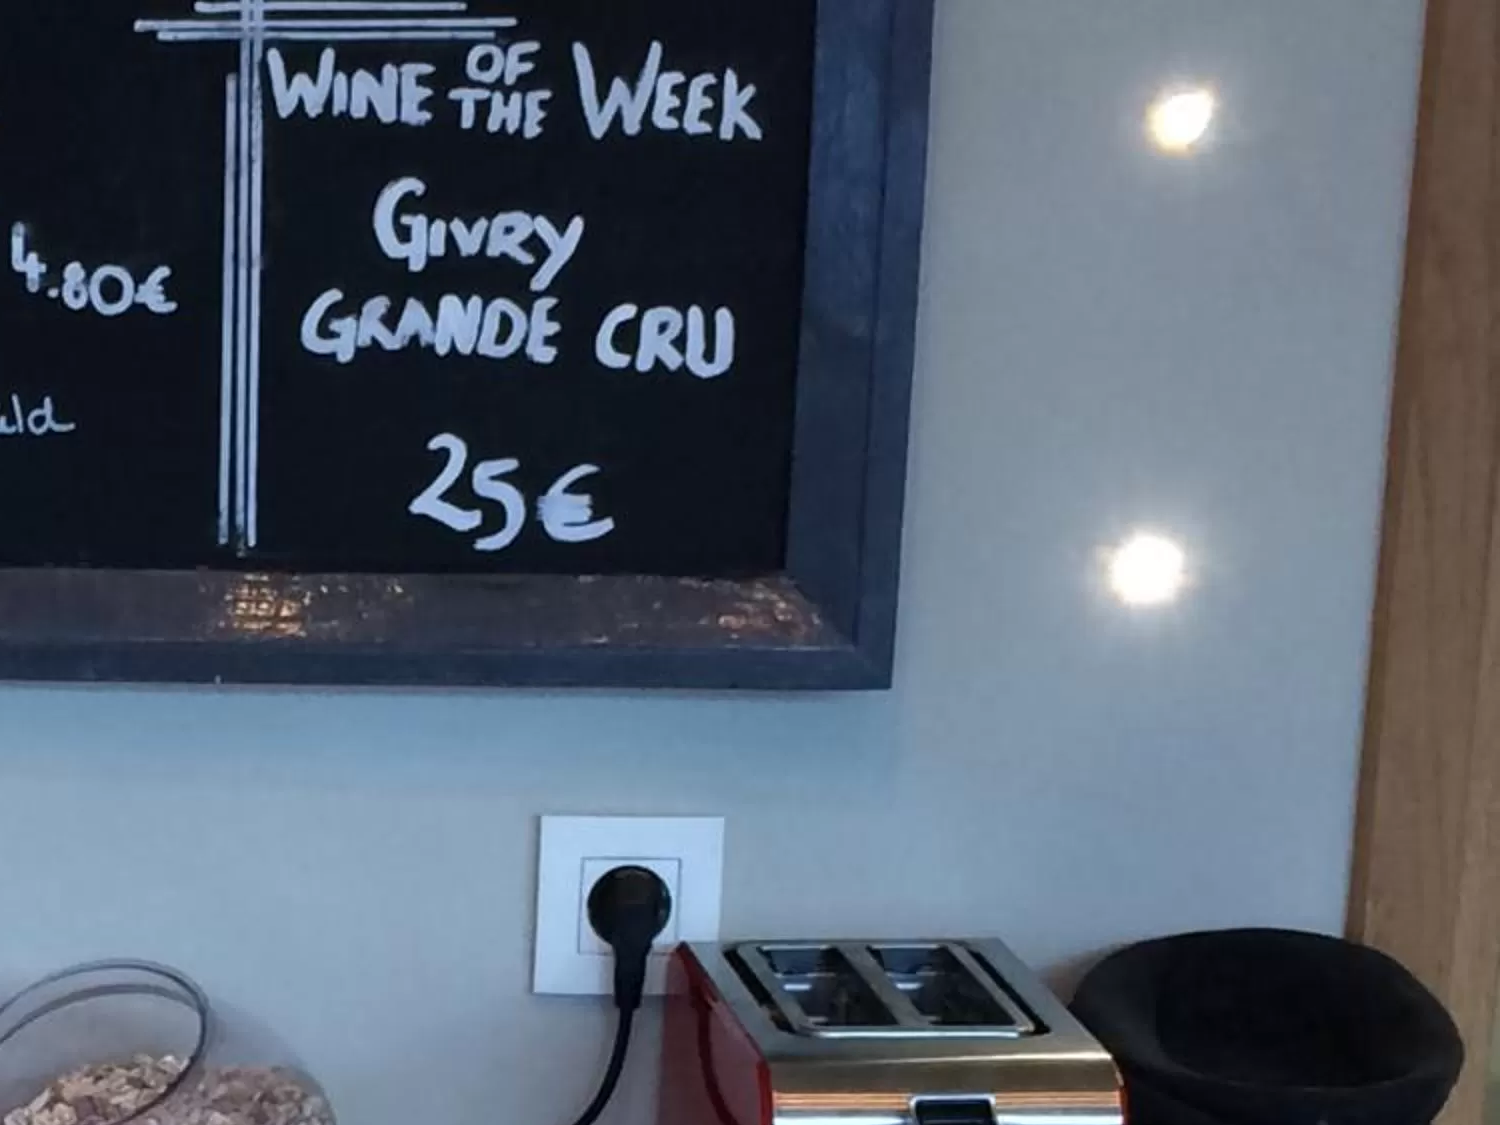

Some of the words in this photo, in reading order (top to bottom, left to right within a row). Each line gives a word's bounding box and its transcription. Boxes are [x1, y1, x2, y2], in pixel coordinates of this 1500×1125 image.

[267, 48, 436, 126] WINE
[466, 41, 542, 86] OF
[572, 41, 763, 141] WEEK
[447, 88, 553, 139] THE
[11, 222, 178, 316] 4.80€
[300, 289, 562, 363] GRANDE
[595, 303, 736, 378] CRU
